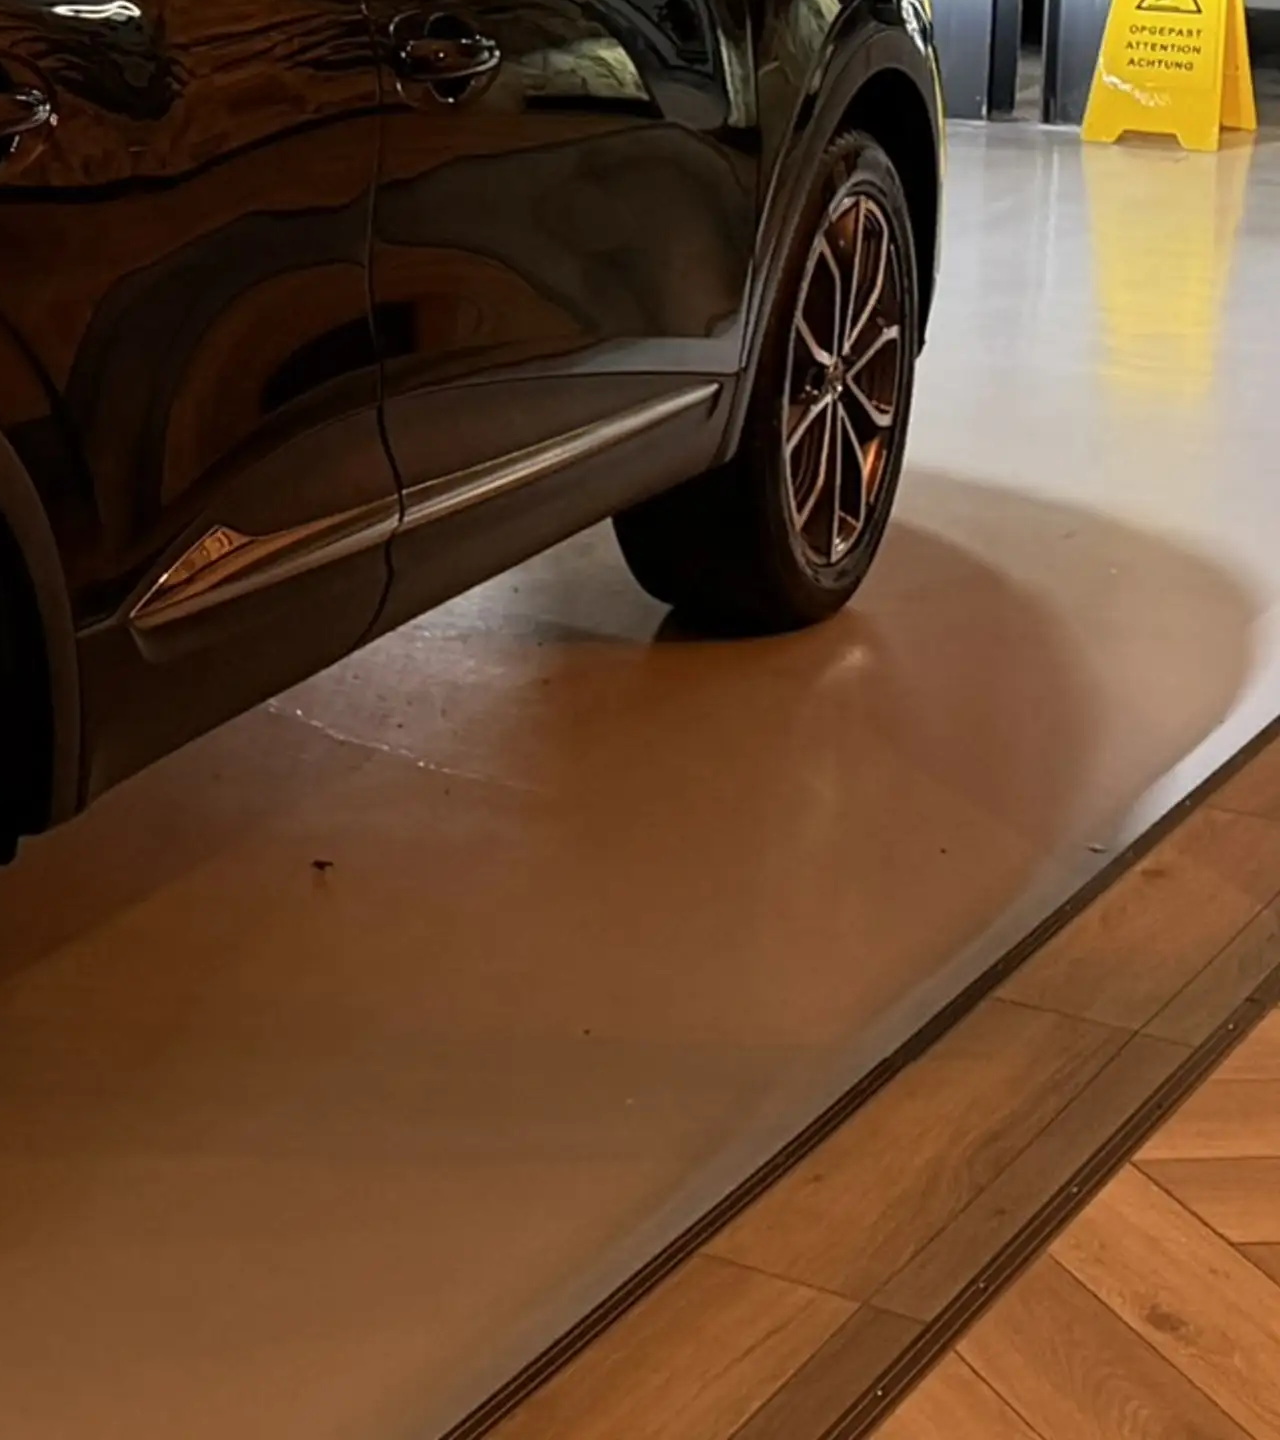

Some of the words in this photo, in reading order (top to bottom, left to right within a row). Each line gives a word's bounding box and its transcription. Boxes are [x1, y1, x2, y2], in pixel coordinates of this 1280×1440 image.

[1129, 24, 1202, 38] OPGEPAST
[1125, 40, 1201, 55] ATTENTION
[1126, 57, 1193, 71] ACHTUNG
